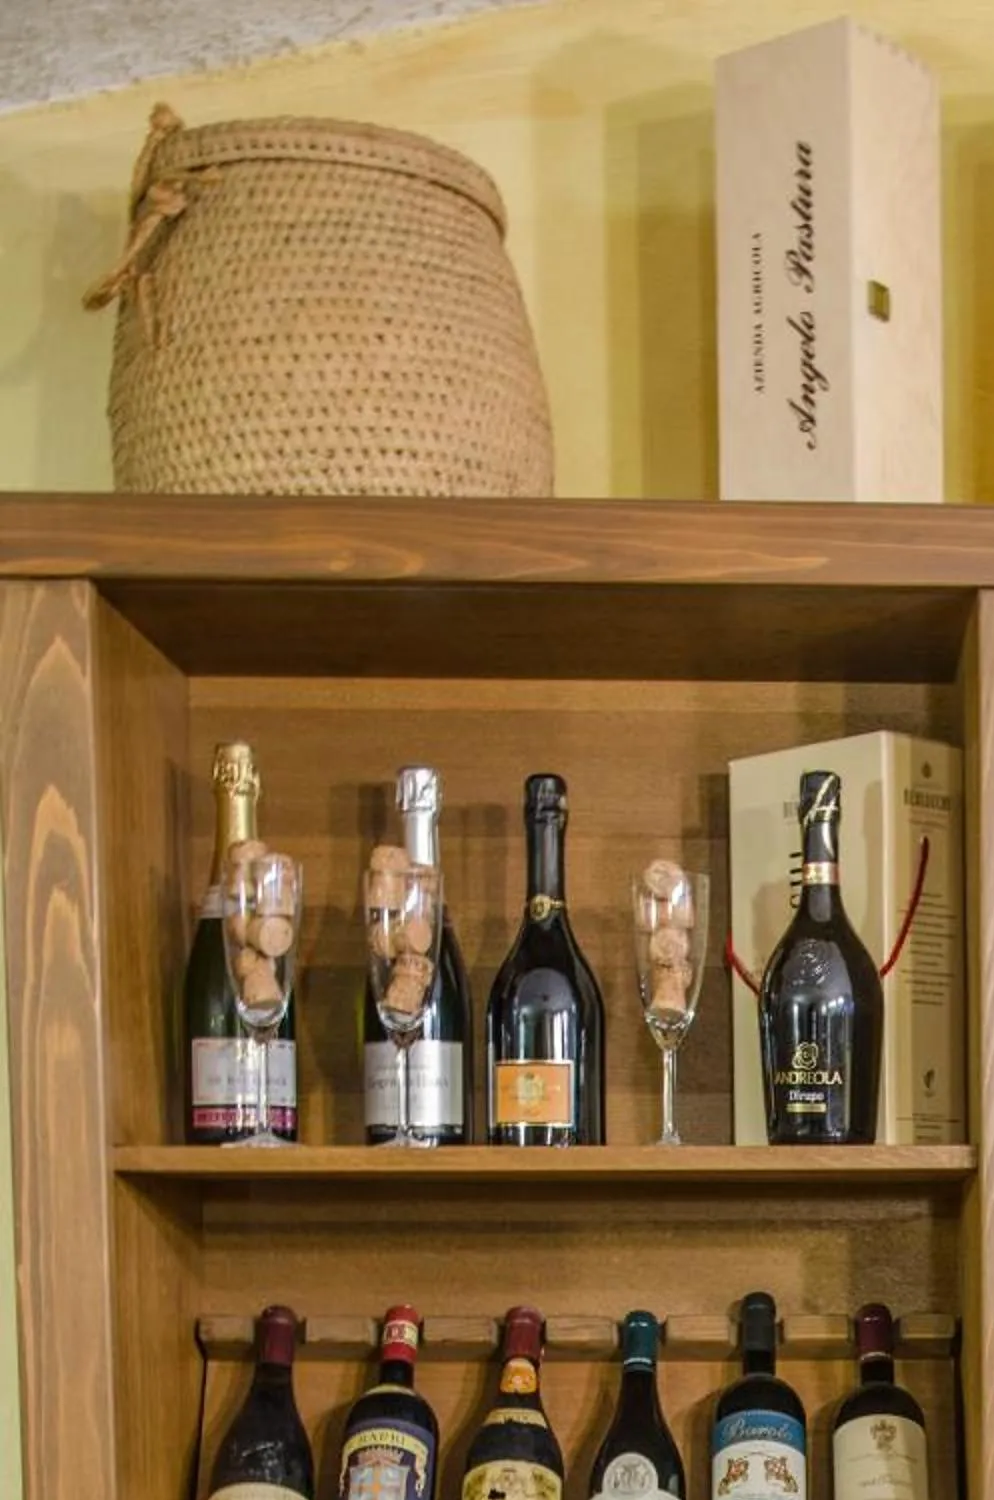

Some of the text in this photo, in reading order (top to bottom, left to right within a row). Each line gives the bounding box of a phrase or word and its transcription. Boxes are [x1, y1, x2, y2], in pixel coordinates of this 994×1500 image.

[751, 231, 765, 395] AZIENDA AGRICOLA
[784, 141, 830, 451] Angelo Pastura
[775, 1070, 844, 1085] ANDREOLA
